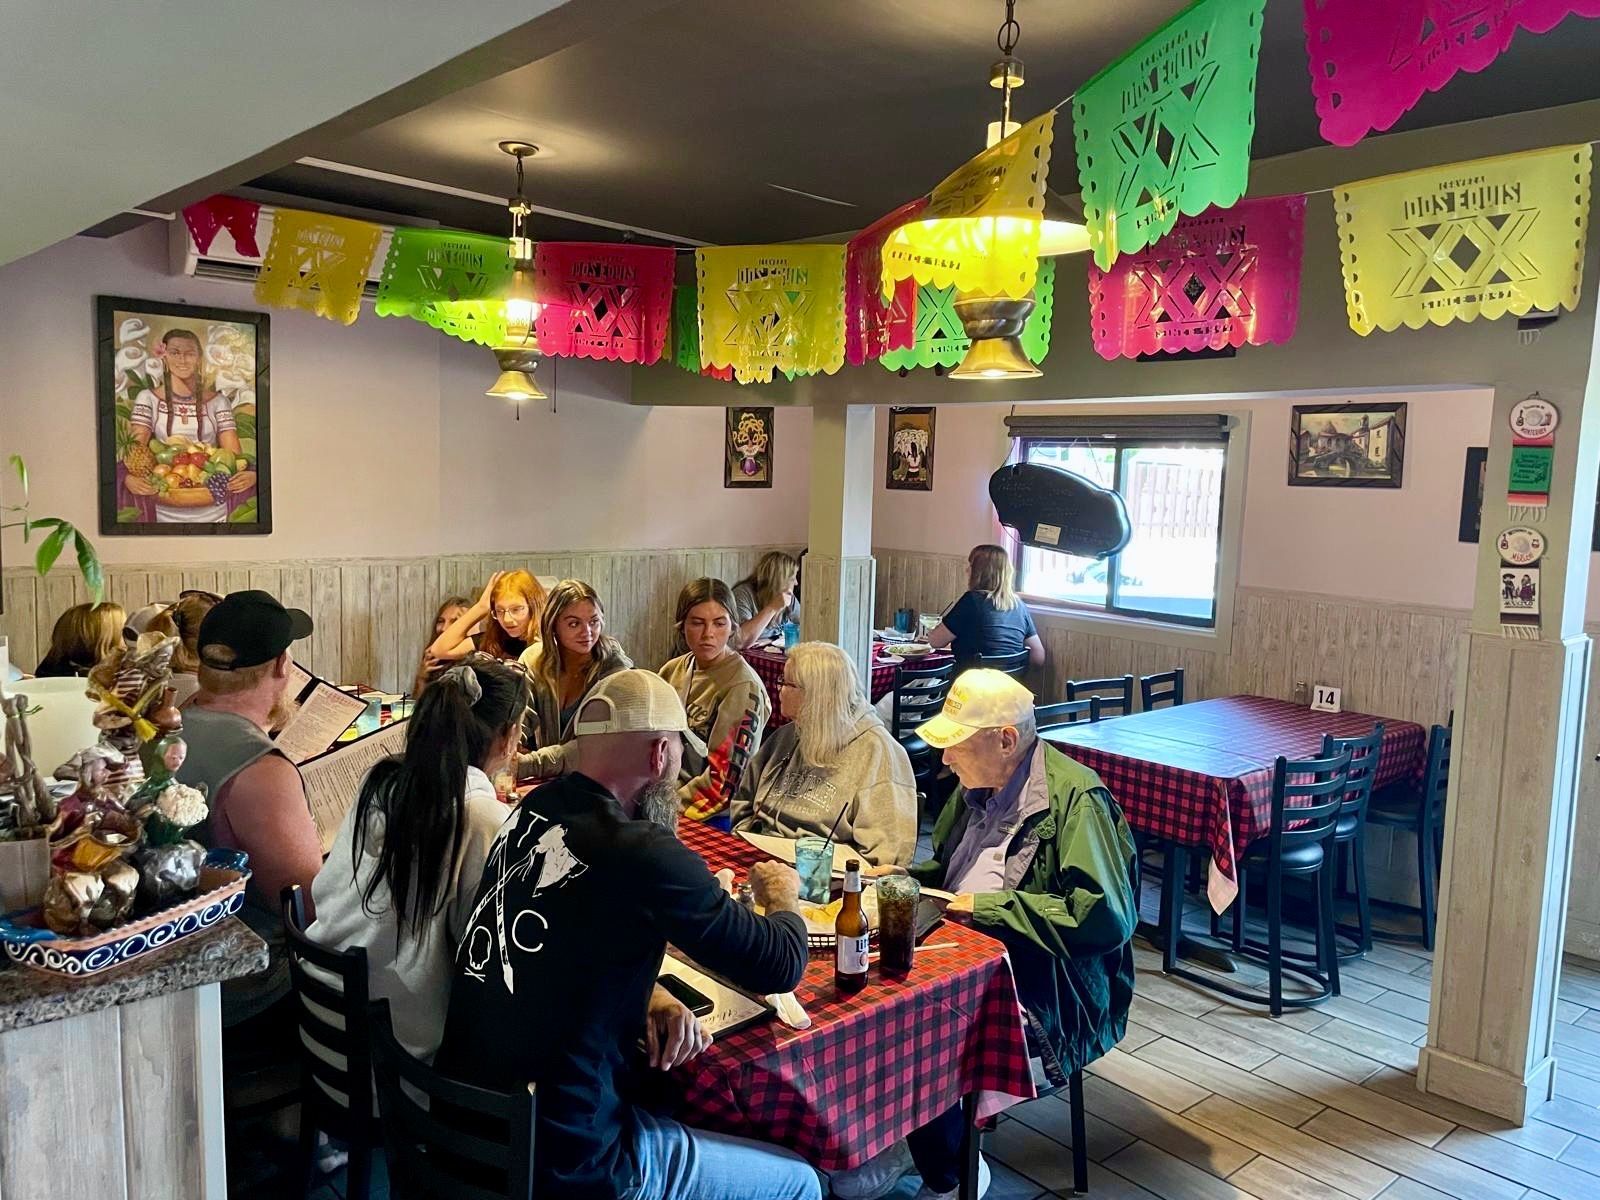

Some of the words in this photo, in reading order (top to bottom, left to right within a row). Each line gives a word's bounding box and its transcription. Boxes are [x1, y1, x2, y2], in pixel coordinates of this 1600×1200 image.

[1404, 193, 1451, 220] DOS
[1454, 182, 1521, 211] EQUIS
[1386, 207, 1542, 299] XX
[1318, 689, 1335, 705] 14
[516, 810, 549, 848] T
[511, 909, 549, 953] C
